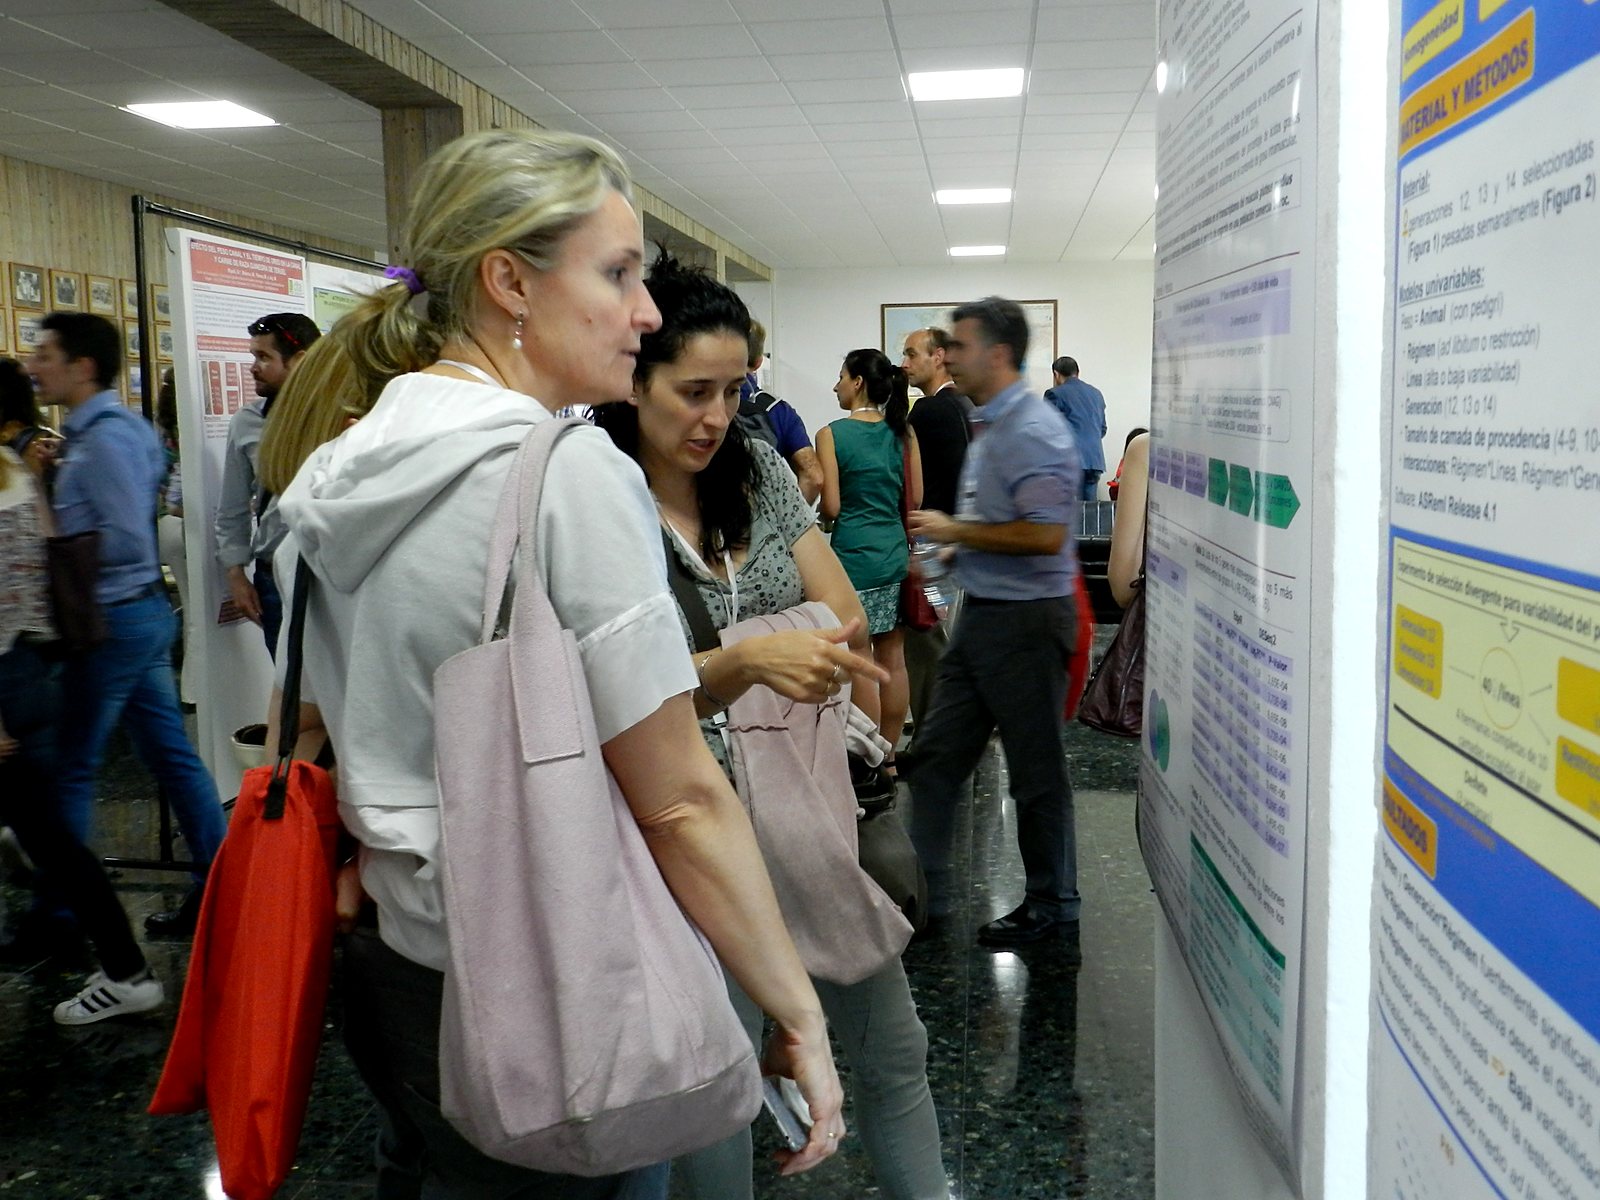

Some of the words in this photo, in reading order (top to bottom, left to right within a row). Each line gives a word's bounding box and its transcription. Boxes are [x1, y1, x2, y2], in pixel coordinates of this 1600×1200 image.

[1452, 84, 1461, 113] Y
[1506, 171, 1516, 193] 14
[1522, 140, 1595, 187] seleccionadas
[1441, 221, 1475, 254] pesadas
[1476, 196, 1540, 238] semanalmente
[1541, 182, 1582, 220] (Figura
[1585, 171, 1597, 203] 2)
[1425, 266, 1486, 297] univariables:
[1419, 303, 1446, 327] Animal
[1440, 428, 1472, 447] camada
[1474, 427, 1486, 446] de
[1487, 427, 1550, 452] procedencia
